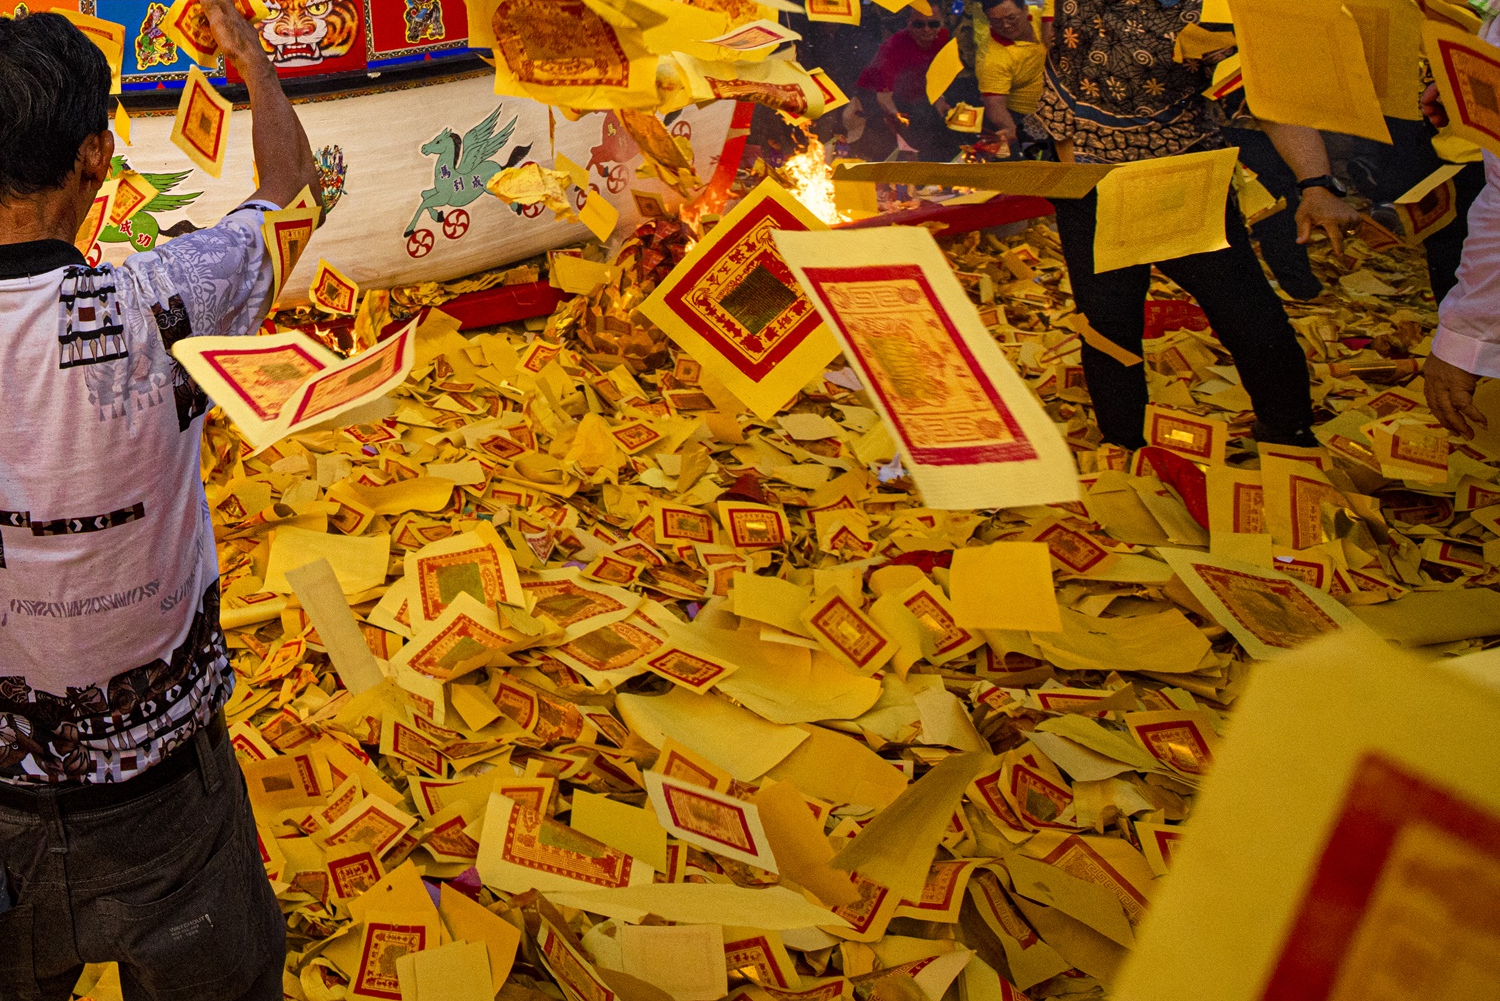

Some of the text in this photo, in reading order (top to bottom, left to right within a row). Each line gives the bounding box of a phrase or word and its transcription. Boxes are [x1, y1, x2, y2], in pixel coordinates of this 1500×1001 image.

[441, 165, 484, 192] 馬到成
[119, 219, 152, 247] 成功
